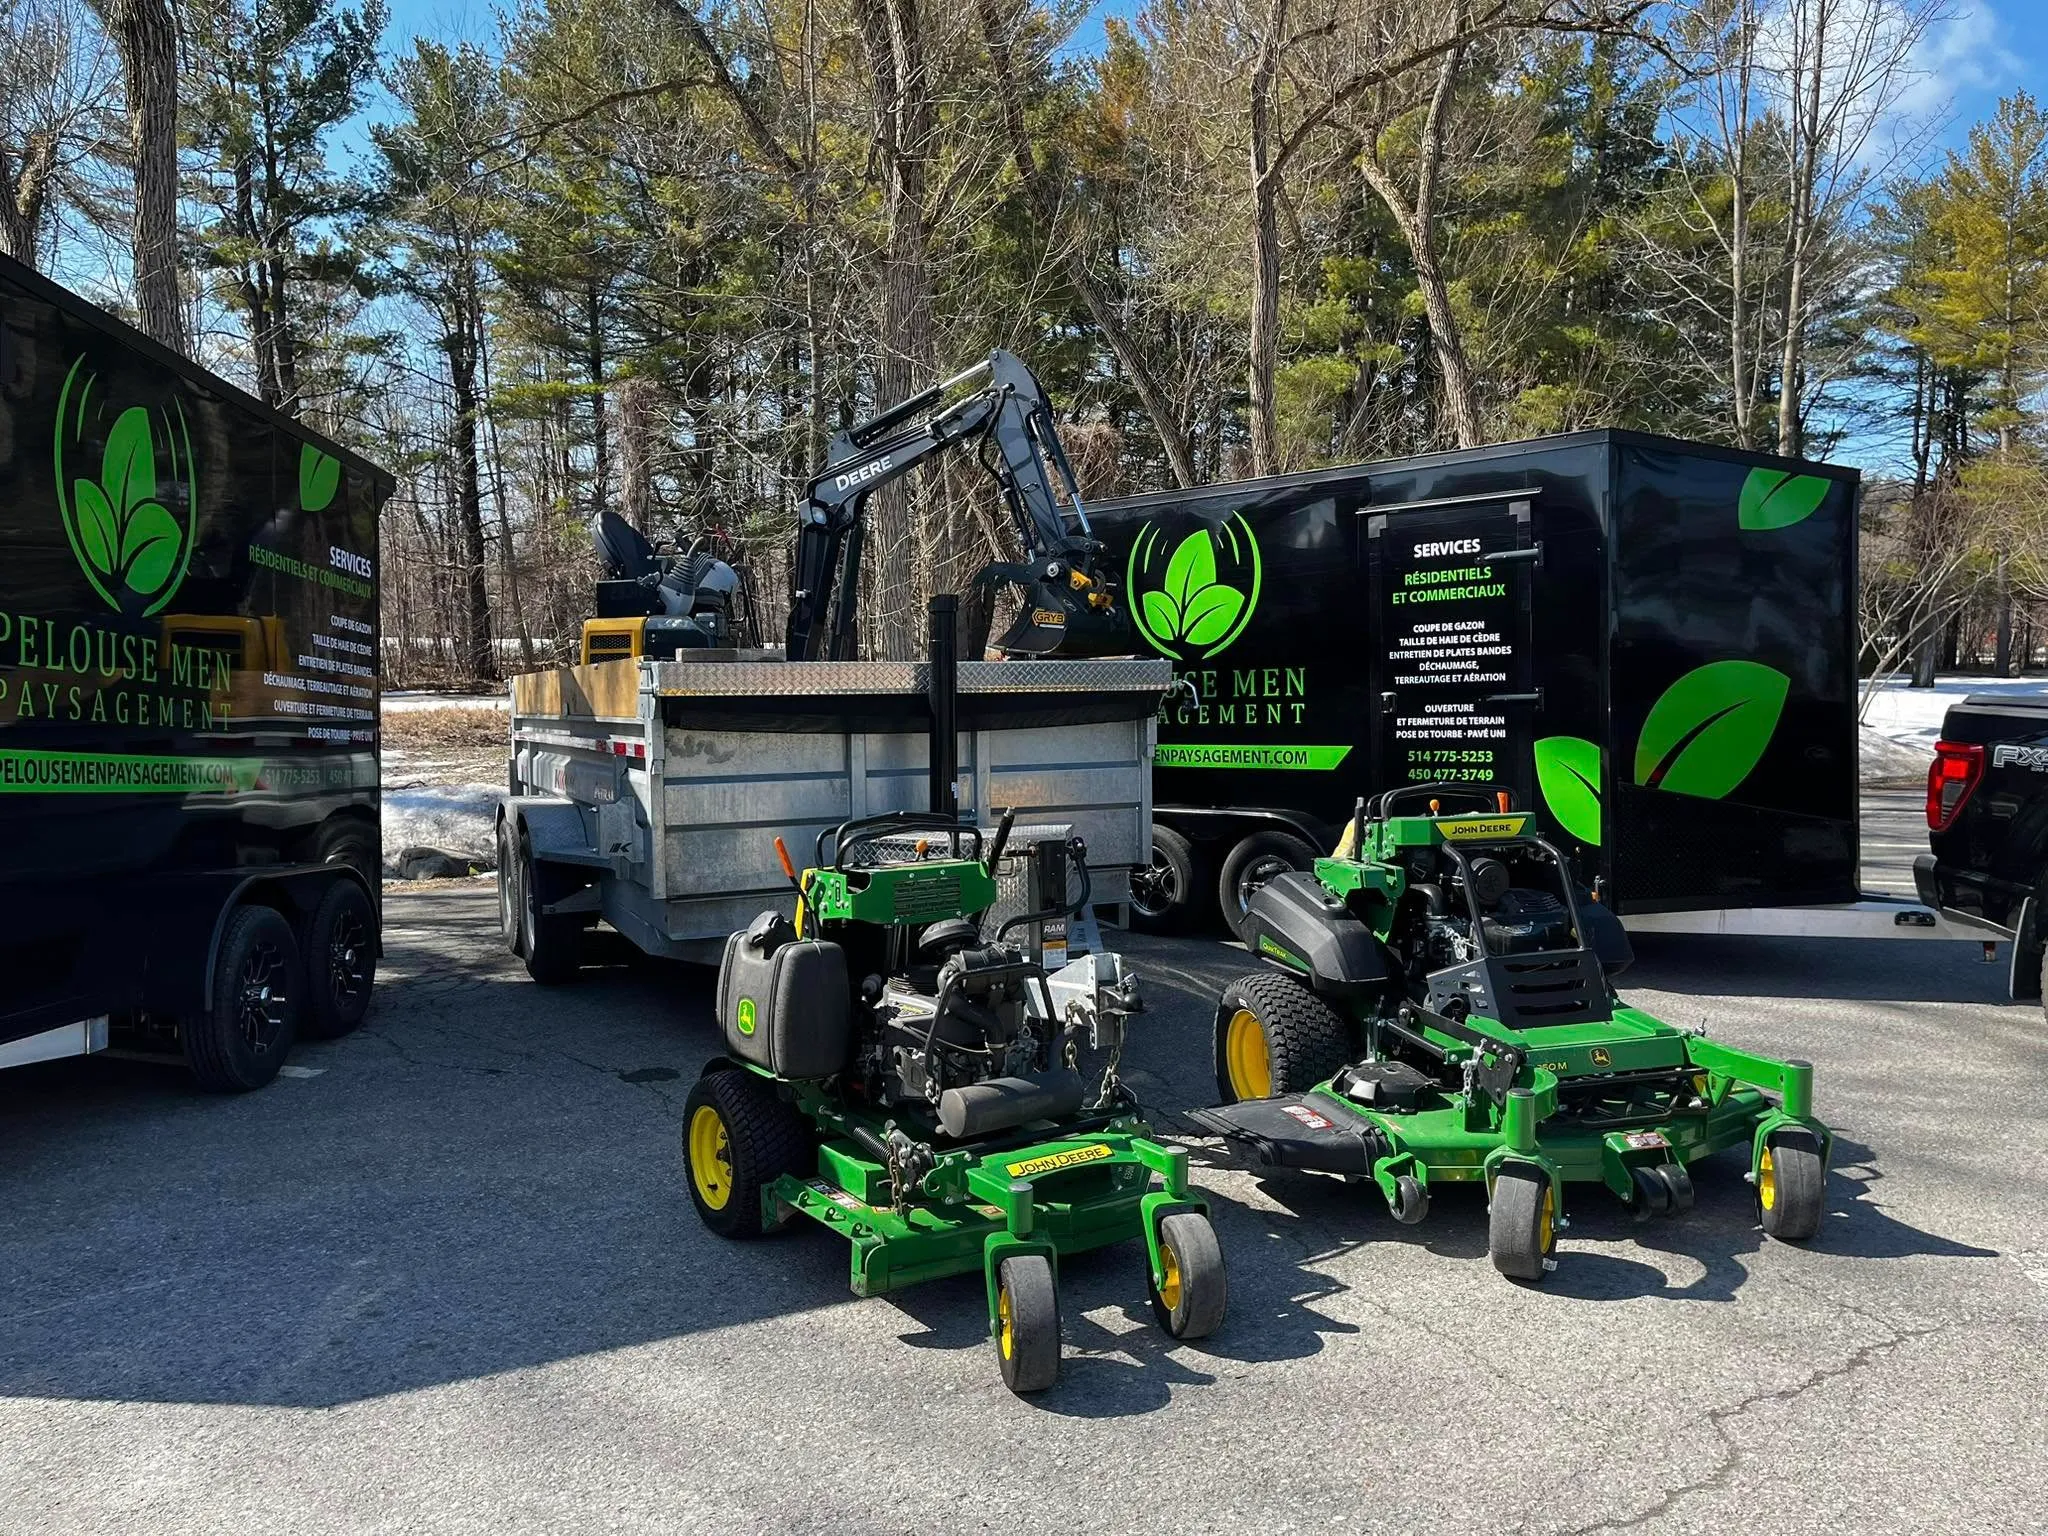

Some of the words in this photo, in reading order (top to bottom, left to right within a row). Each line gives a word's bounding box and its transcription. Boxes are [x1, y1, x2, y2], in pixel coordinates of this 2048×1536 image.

[835, 455, 893, 492] DEERE
[1414, 539, 1481, 558] SERVICES
[330, 546, 372, 578] SERVICES
[249, 544, 307, 578] RÉSIDENTIELS
[308, 565, 318, 582] ET
[320, 570, 372, 599] COMMERCIAUX
[1404, 566, 1492, 586] RÉSIDENTIELS
[1392, 592, 1407, 604] ET
[1410, 584, 1506, 603] COMMERCIAUX
[331, 615, 347, 628] COUPE
[348, 620, 355, 630] DE
[1413, 623, 1440, 633] COUPE
[1442, 623, 1453, 631] DE
[1454, 621, 1485, 630] GAZON
[312, 633, 330, 647] TAILLE
[330, 638, 338, 649] DE
[1399, 637, 1425, 646] TAILLE
[1426, 636, 1438, 645] DE
[1438, 635, 1459, 644] HAIE
[1460, 634, 1471, 644] DE
[1472, 632, 1501, 643] CÈDRE
[1389, 650, 1432, 660] ENTRETIEN
[1433, 649, 1445, 658] DE
[1446, 648, 1476, 657] PLATES
[1477, 646, 1512, 656] BANDES
[172, 643, 231, 692] MEN
[299, 654, 328, 670] ENTRETIEN
[328, 660, 336, 671] DE
[336, 661, 353, 675] PLATES
[1419, 660, 1480, 671] DÉCHAUMAGE,
[264, 671, 306, 692] DÉCHAUMAGE,
[306, 680, 342, 695] TERREAUTAGE
[343, 684, 350, 696] ET
[1232, 667, 1306, 698] MEN
[1395, 675, 1451, 685] TERREAUTAGE
[1452, 674, 1462, 683] ET
[1463, 672, 1506, 682] AÉRATION
[274, 700, 308, 714] OUVERTURE
[309, 703, 316, 714] ET
[1425, 703, 1475, 713] OUVERTURE
[1396, 718, 1407, 726] ET
[1407, 717, 1455, 726] FERMETURE
[1456, 716, 1467, 725] DE
[1469, 716, 1504, 725] TERRAIN
[1396, 730, 1417, 739] POSE
[1418, 730, 1429, 738] DE
[1430, 730, 1462, 738] TOURBE
[1467, 728, 1489, 738] PAVÉ
[1490, 729, 1506, 738] UNI
[1408, 750, 1431, 762] 514
[1433, 751, 1493, 762] 775-5253
[0, 758, 233, 785] ELOUSEMENPAYSAGEMENT.COM
[1408, 769, 1431, 780] 450
[1433, 769, 1494, 781] 477-3749
[1452, 826, 1478, 834] JOHN
[1480, 824, 1512, 832] DEERE
[1043, 924, 1065, 933] RAM
[1018, 1158, 1056, 1175] JOHN
[1056, 1147, 1104, 1165] DEERE
